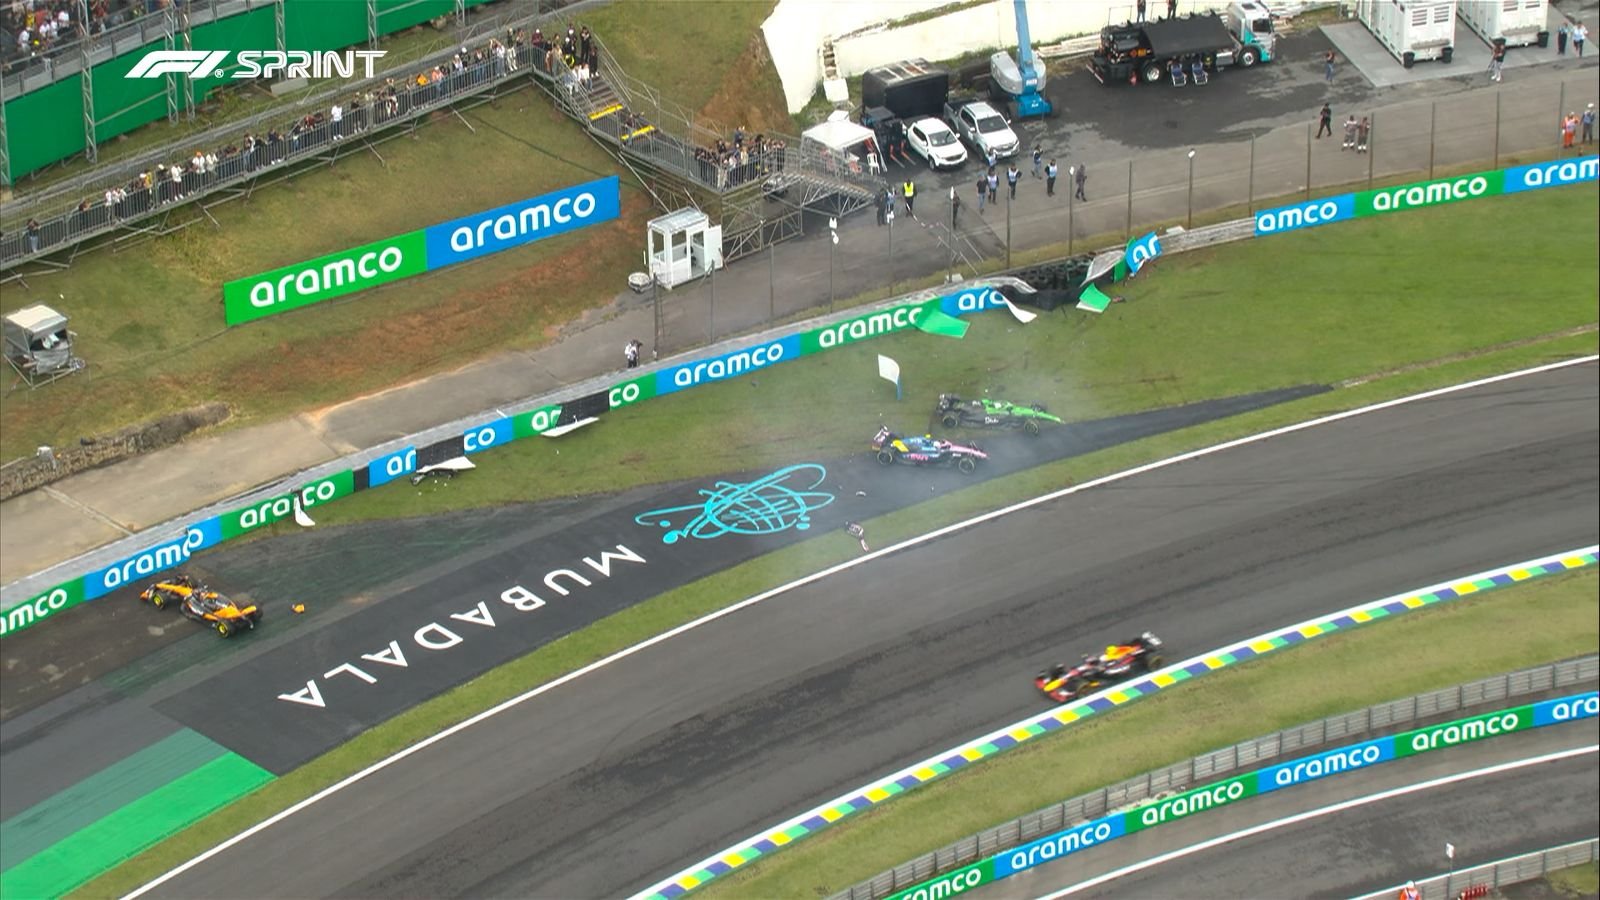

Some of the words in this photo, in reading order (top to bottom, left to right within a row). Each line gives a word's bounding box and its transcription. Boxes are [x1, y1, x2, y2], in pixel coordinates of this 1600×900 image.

[1373, 176, 1487, 210] aramco
[450, 193, 596, 252] aramco
[1255, 202, 1337, 231] amco
[250, 246, 402, 307] aramco
[674, 343, 783, 386] aramco
[277, 544, 647, 708] MUBADALA
[1412, 713, 1518, 751] aramco
[1276, 746, 1380, 785] aramco
[1142, 782, 1244, 825] aramco
[1011, 823, 1111, 870] aramco
